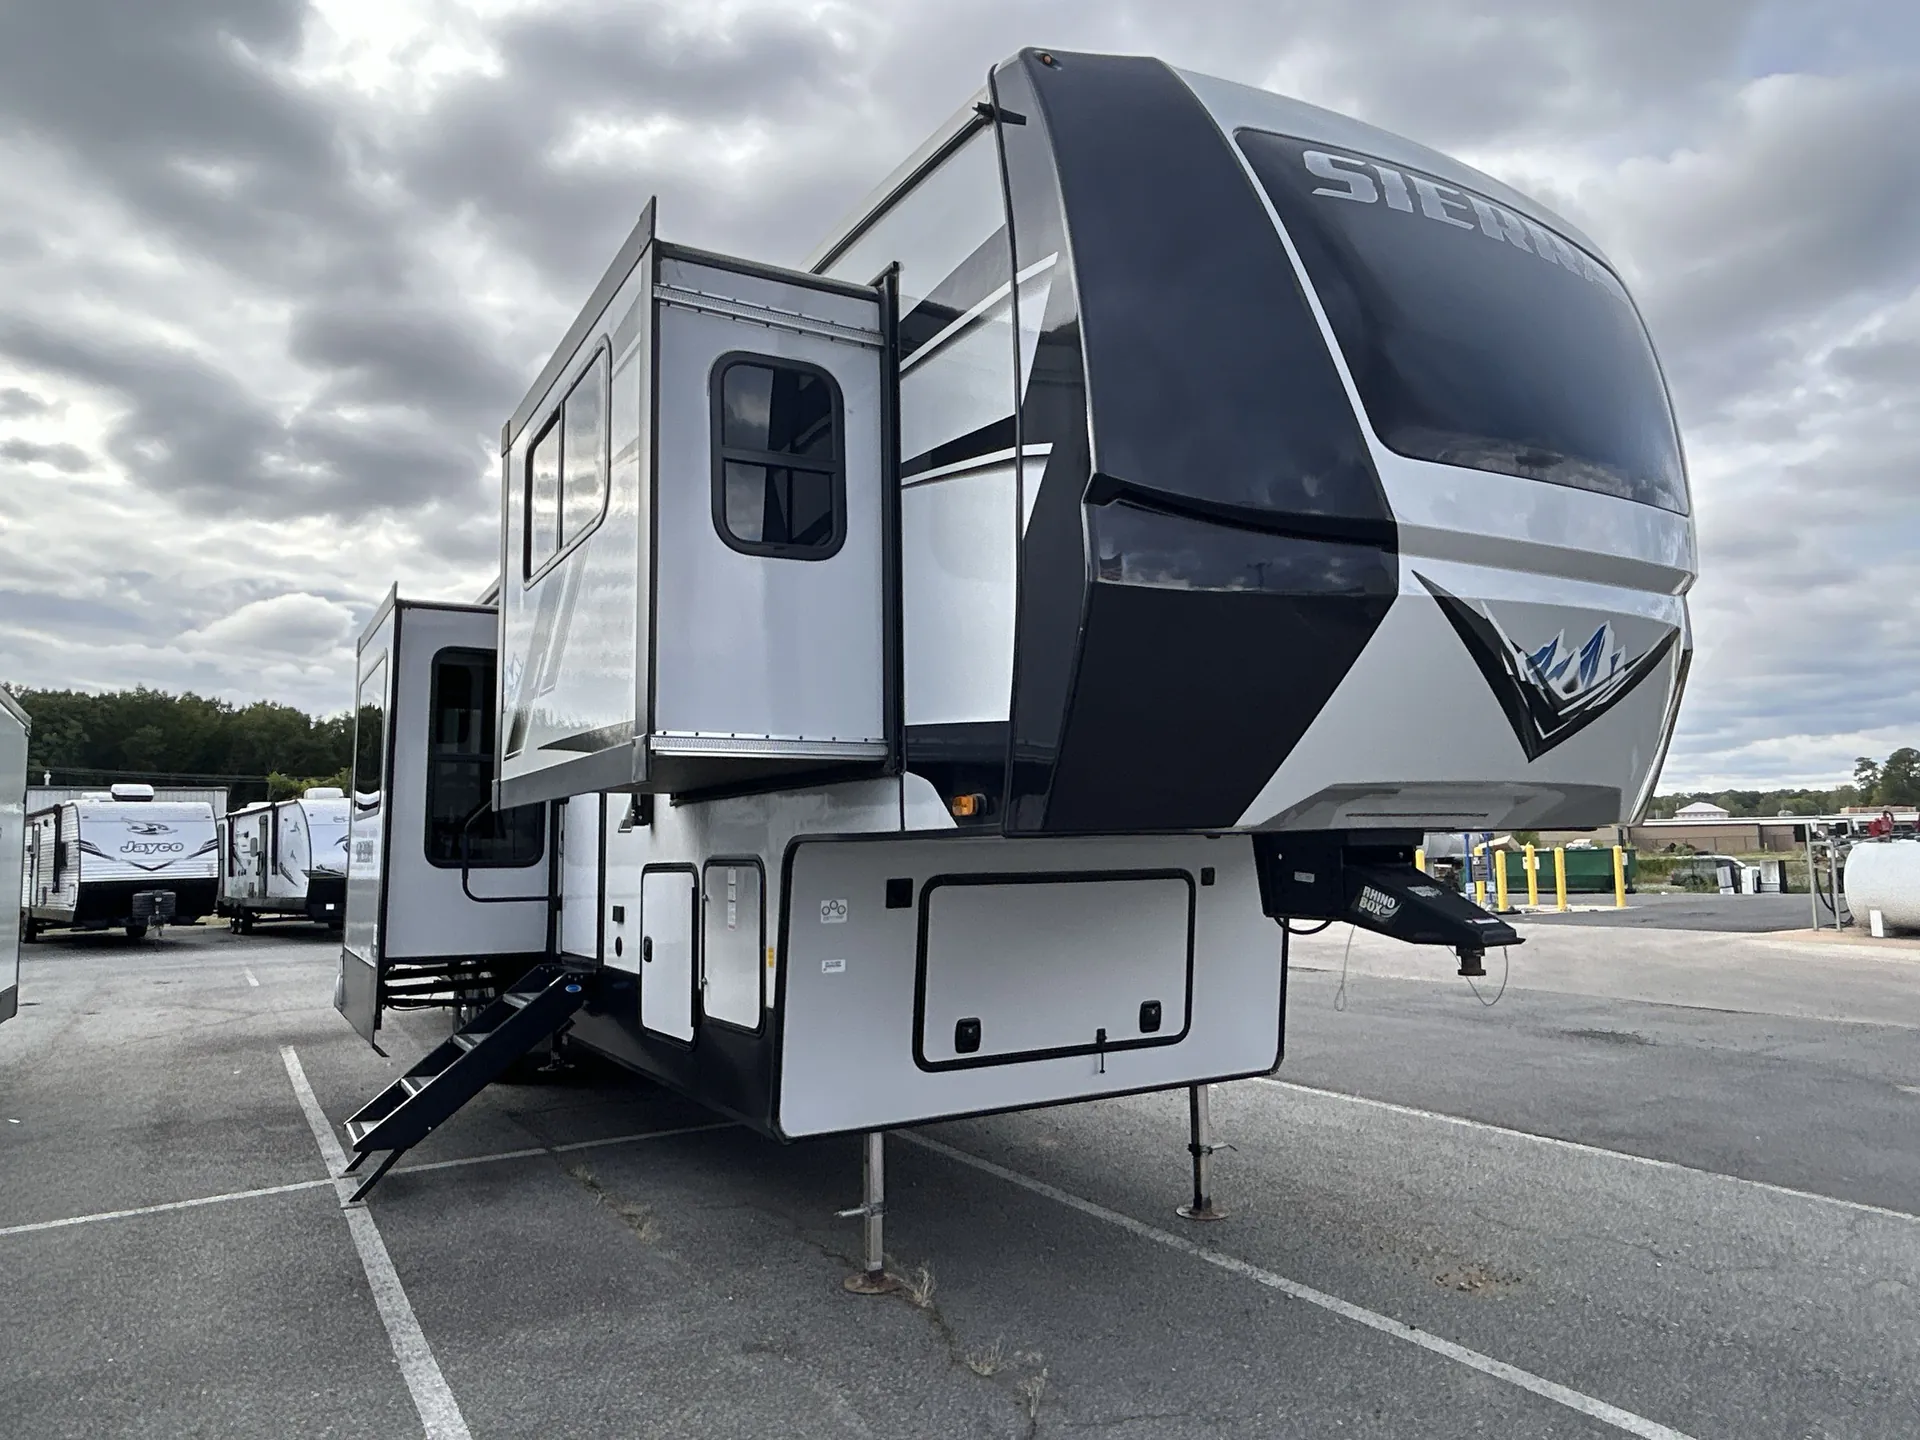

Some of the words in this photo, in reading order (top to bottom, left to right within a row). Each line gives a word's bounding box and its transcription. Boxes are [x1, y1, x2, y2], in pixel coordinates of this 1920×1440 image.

[120, 841, 184, 855] Jayco
[1359, 896, 1382, 915] BOX
[1363, 886, 1395, 908] RHINO
